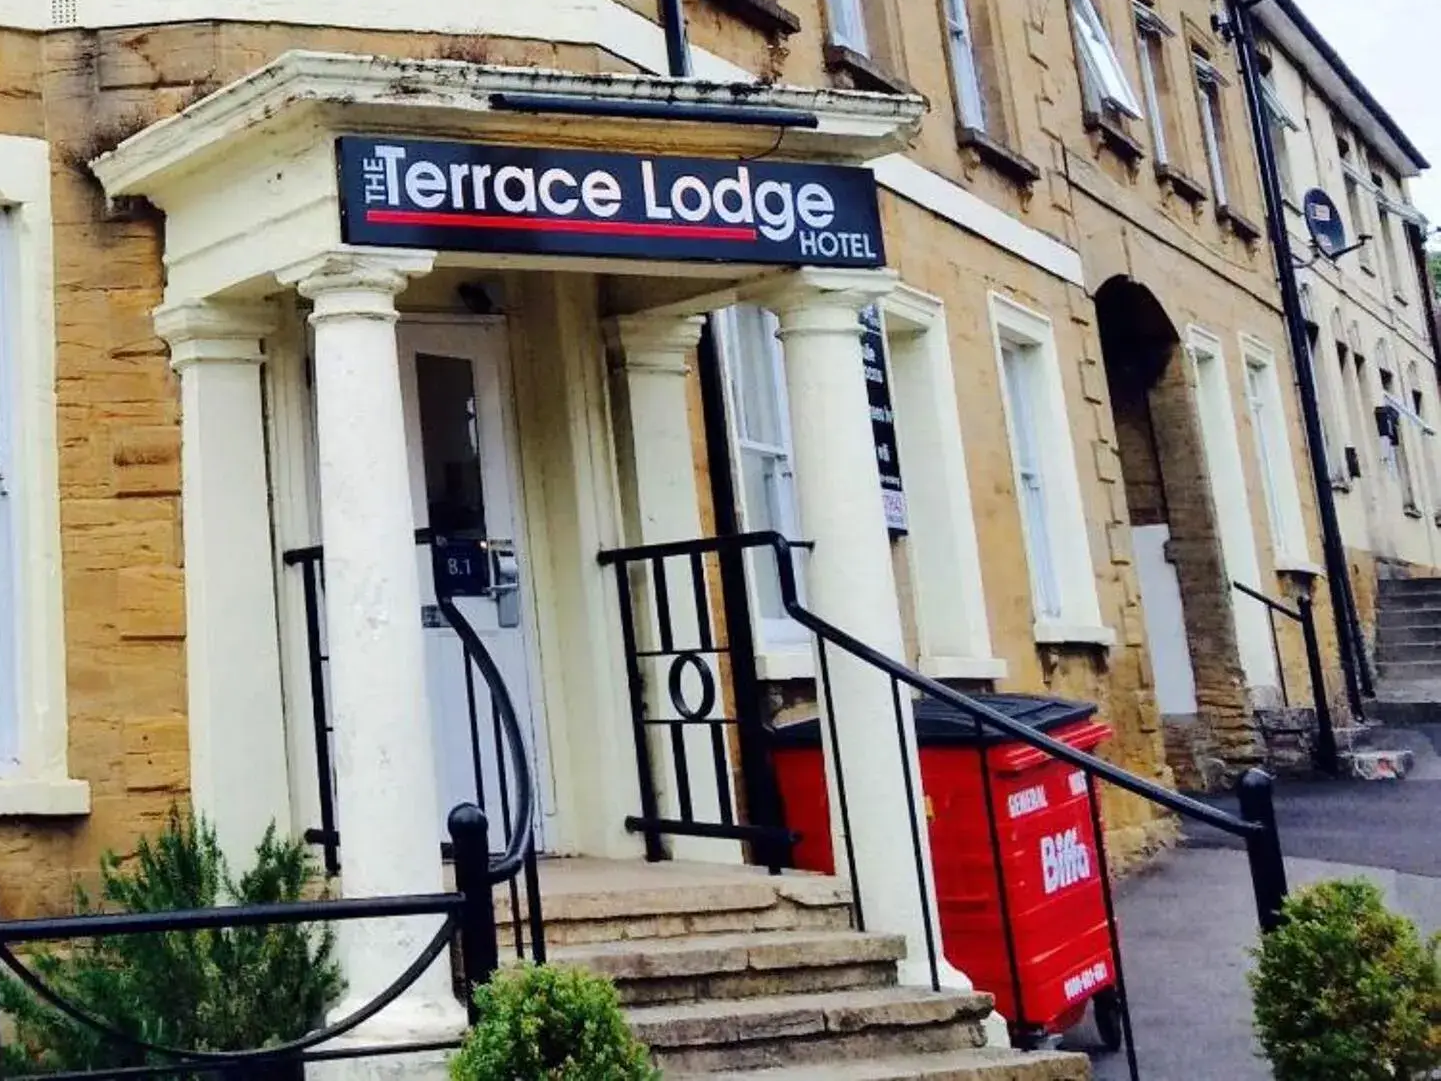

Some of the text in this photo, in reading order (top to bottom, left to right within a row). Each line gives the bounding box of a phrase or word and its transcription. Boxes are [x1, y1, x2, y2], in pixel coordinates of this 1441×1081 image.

[363, 145, 877, 259] THE Terrace Lodge HOTEL
[1040, 826, 1090, 894] Biffa
